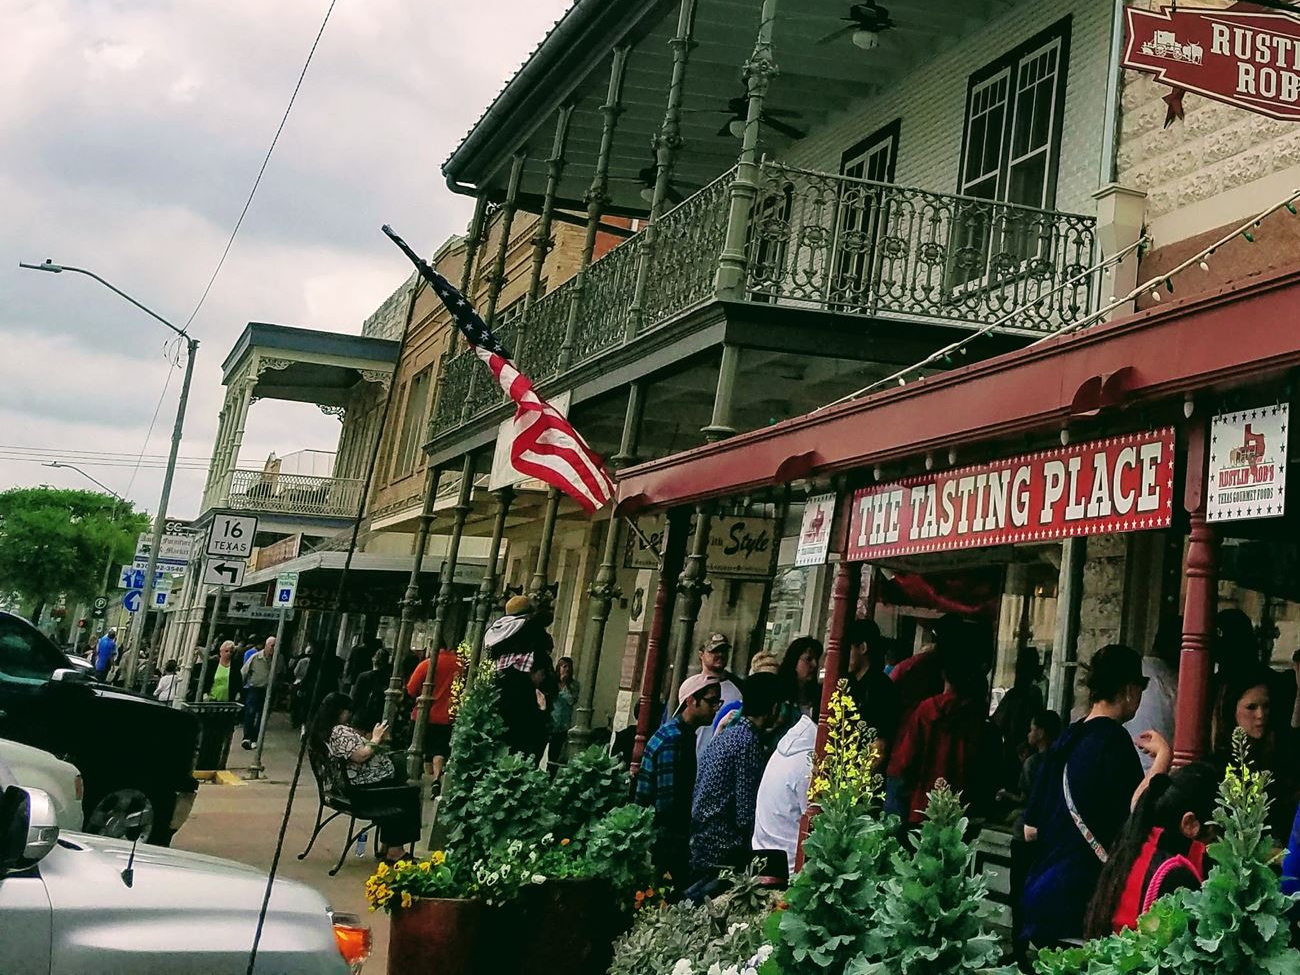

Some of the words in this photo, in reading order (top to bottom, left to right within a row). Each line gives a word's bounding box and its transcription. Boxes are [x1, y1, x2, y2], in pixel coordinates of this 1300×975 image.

[857, 489, 902, 547] THE
[909, 465, 1032, 541] TASTING
[1039, 441, 1163, 524] PLACE
[1257, 487, 1274, 501] FOODS
[224, 520, 243, 538] 16
[215, 541, 247, 552] TEXAS
[723, 521, 769, 559] Style
